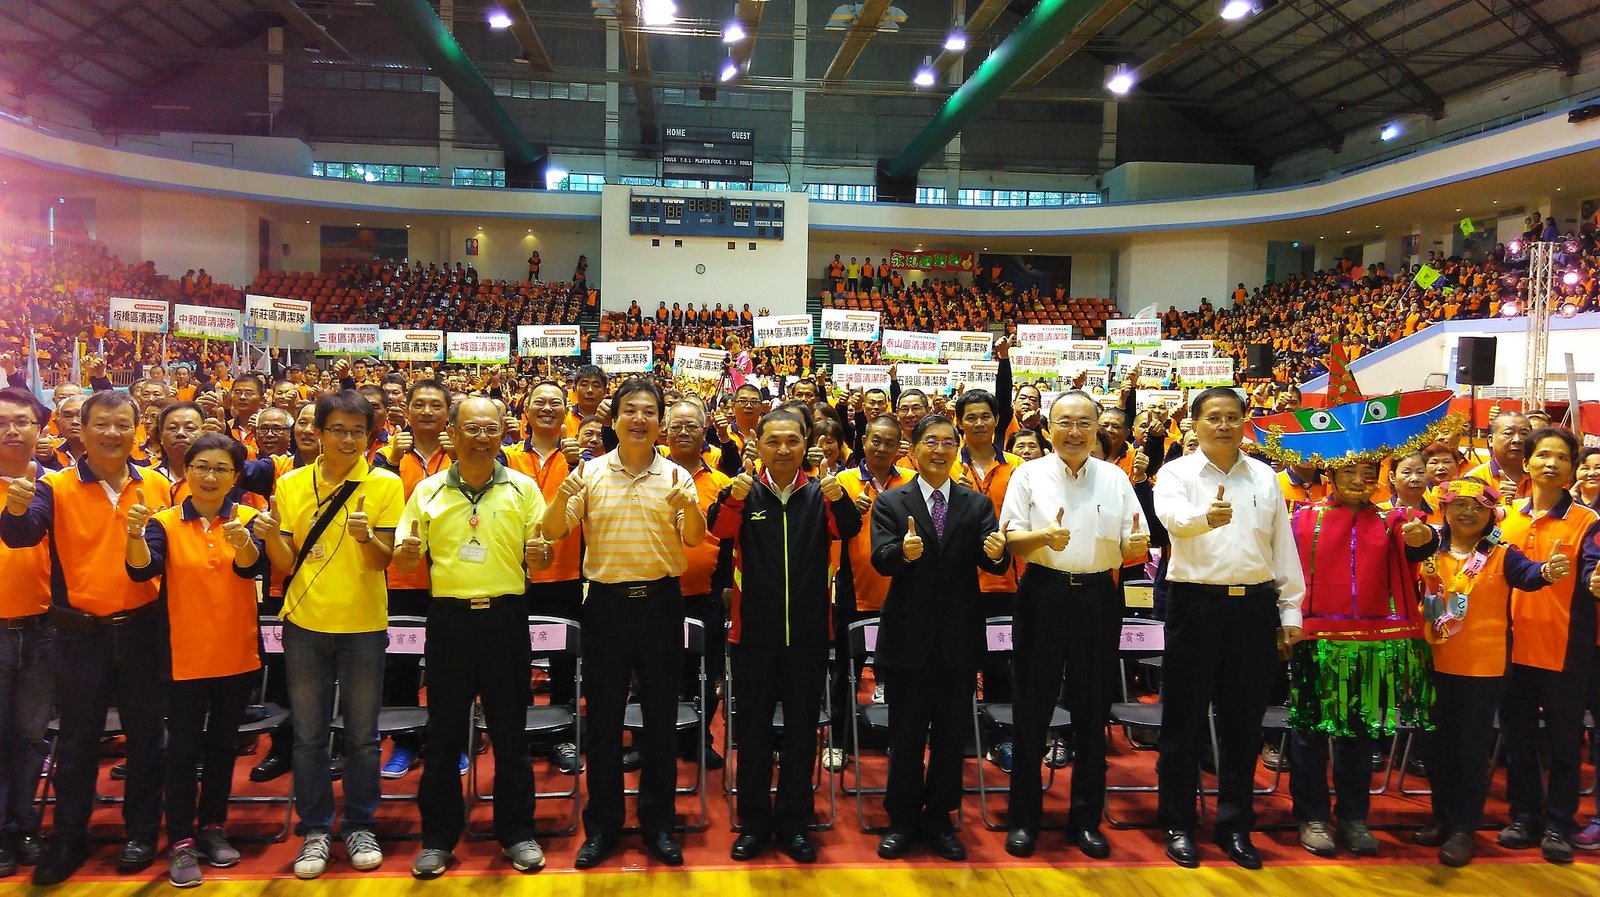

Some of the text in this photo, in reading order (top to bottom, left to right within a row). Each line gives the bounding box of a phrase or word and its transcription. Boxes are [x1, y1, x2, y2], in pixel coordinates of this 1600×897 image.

[666, 128, 686, 137] HOME
[731, 131, 751, 140] GUEST
[113, 310, 164, 324] 板橋區清潔隊
[178, 314, 236, 330] 中和區清潔隊
[249, 308, 306, 325] 新莊區清潔隊
[757, 326, 809, 339] 樹林區清潔隊
[1110, 326, 1159, 337] 坪林區清潔隊
[318, 332, 376, 344] 三重區清潔隊
[521, 337, 576, 349] 永和區清潔隊
[383, 341, 439, 354] 新店區清潔隊
[451, 341, 507, 353] 土城區清潔隊
[886, 338, 937, 351] 泰山區清潔隊
[940, 341, 988, 353] 石門區清潔隊
[1060, 350, 1101, 361] 溪區清潔隊
[1120, 364, 1167, 379] 石區清潔隊
[1180, 366, 1230, 376] 萬里區清潔隊
